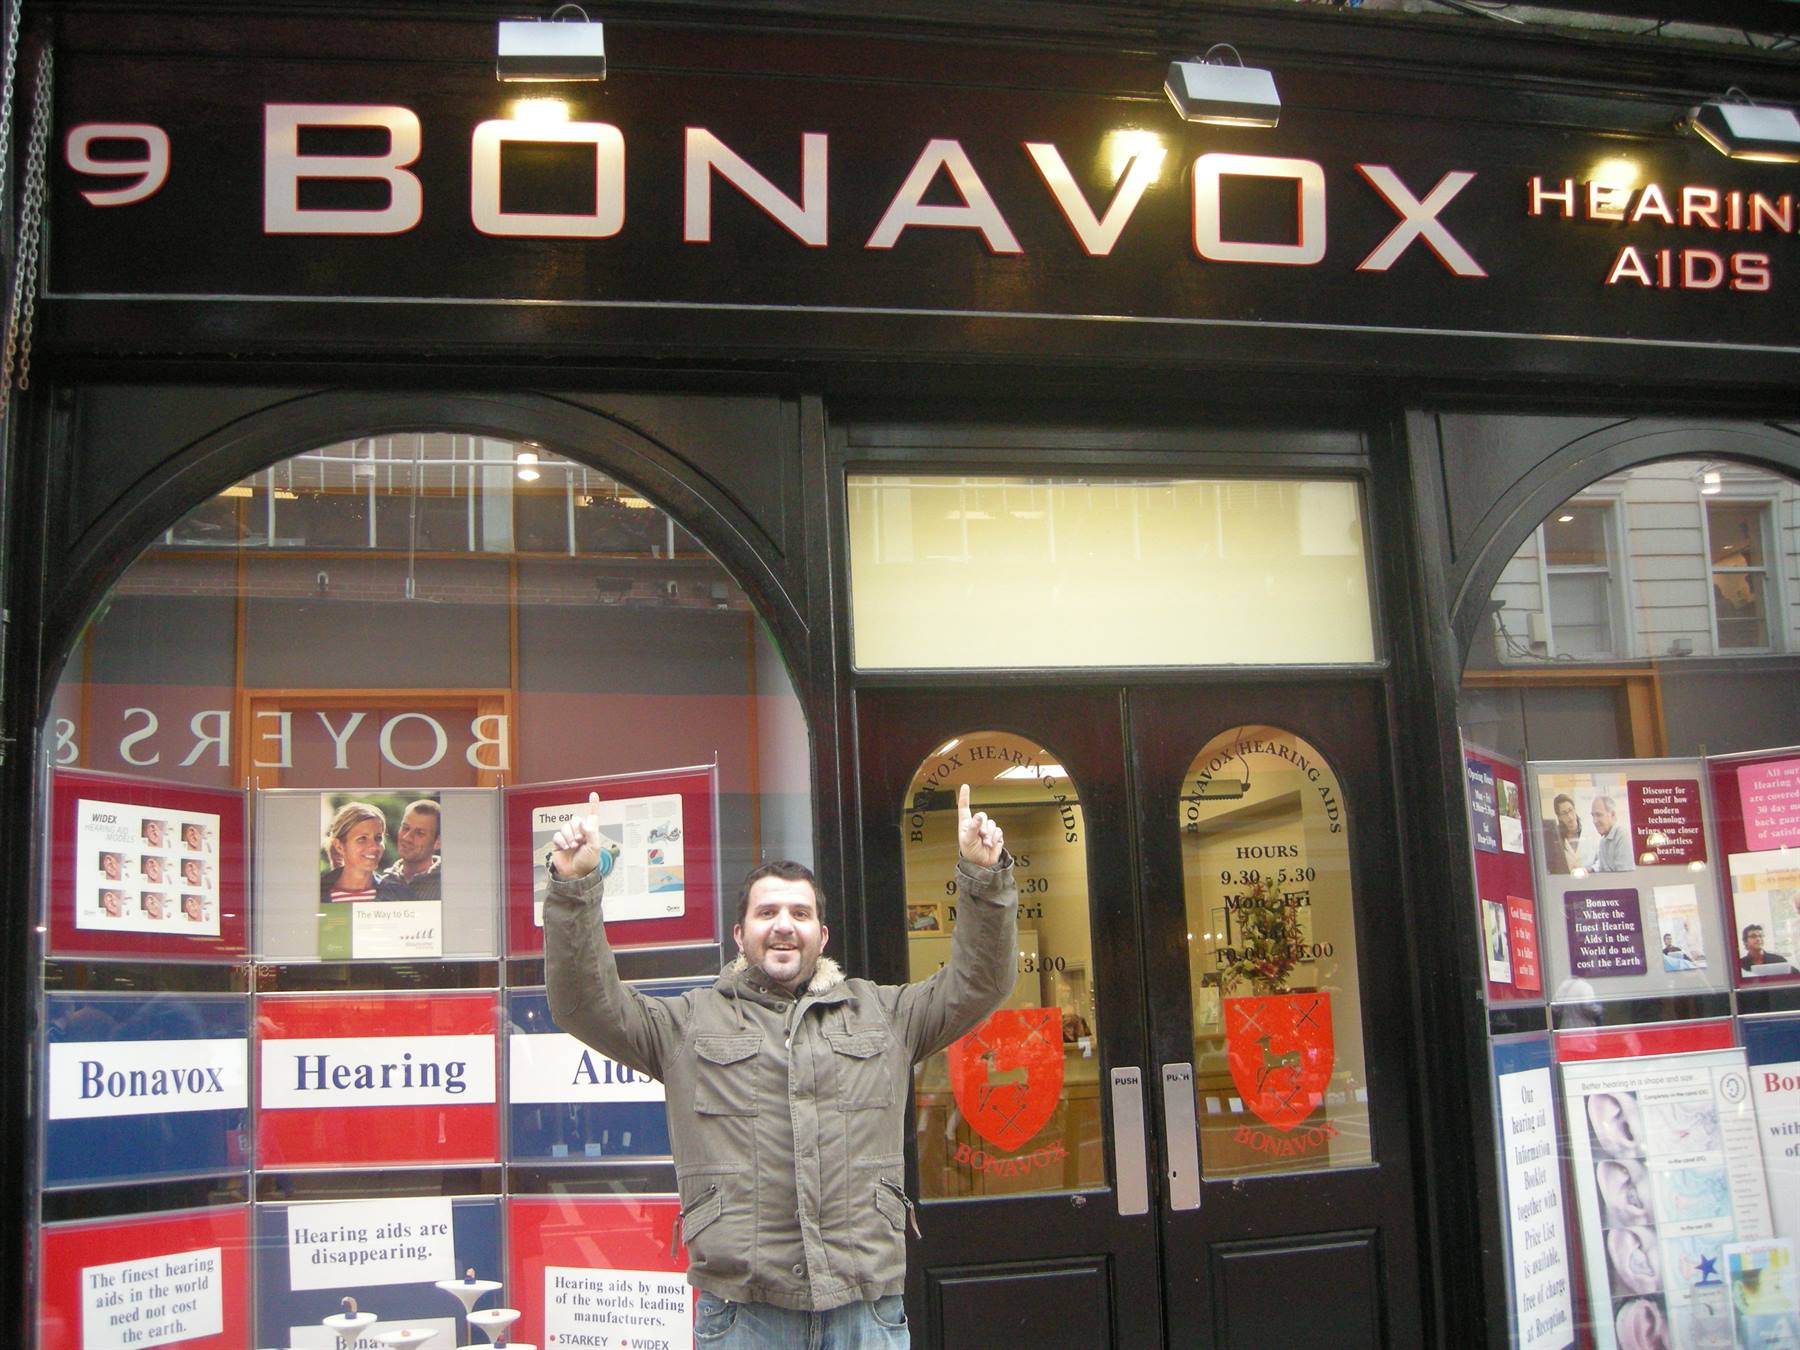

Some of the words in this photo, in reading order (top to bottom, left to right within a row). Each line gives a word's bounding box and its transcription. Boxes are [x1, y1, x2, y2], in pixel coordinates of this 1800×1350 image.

[65, 124, 171, 207] 9
[263, 103, 1488, 278] BONAVOX
[1528, 176, 1800, 233] HEARIN
[1604, 246, 1769, 291] AIDS
[1187, 748, 1234, 833] BONAVOX
[1239, 740, 1321, 783] HEARING
[1318, 785, 1342, 834] AIDS
[1642, 787, 1672, 795] Discover
[1675, 786, 1686, 794] for
[1754, 779, 1791, 790] Hearing
[969, 745, 1057, 790] HEARING
[1053, 793, 1078, 843] AIDS
[1642, 796, 1671, 805] yourself
[1749, 795, 1764, 803] are
[1767, 790, 1800, 801] covered
[92, 813, 118, 824] WIDEX
[539, 813, 557, 824] The
[1770, 805, 1785, 814] day
[1648, 816, 1685, 825] technology
[1754, 816, 1777, 826] back
[1678, 826, 1699, 834] closer
[1758, 829, 1768, 839] of
[1236, 844, 1298, 859] HOURS
[1656, 847, 1685, 855] hearing
[1221, 869, 1260, 885] 9.30
[1278, 867, 1316, 883] 5.30
[1224, 895, 1266, 910] Mon
[1283, 892, 1311, 908] Fri
[1585, 898, 1620, 908] Bonavox
[1583, 910, 1610, 919] Where
[1612, 910, 1625, 918] the
[1575, 923, 1598, 932] finest
[1602, 921, 1635, 931] Hearing
[1584, 934, 1602, 944] Aids
[1605, 934, 1614, 943] in
[1616, 933, 1630, 942] the
[1580, 946, 1606, 956] World
[1609, 946, 1619, 955] do
[1621, 945, 1635, 954] not
[1576, 959, 1595, 969] cost
[1598, 958, 1612, 967] the
[1615, 956, 1641, 966] Earth
[79, 1059, 225, 1100] Bonavox
[294, 1052, 467, 1094] Hearing
[1115, 1077, 1138, 1086] PUSH
[1521, 1086, 1534, 1104] Our
[1512, 1113, 1535, 1135] hearing
[1537, 1109, 1546, 1128] aid
[1233, 1119, 1341, 1157] BONAVOX
[954, 1138, 1071, 1177] BONAVOX
[1515, 1140, 1550, 1165] Information
[1524, 1167, 1546, 1190] Booklet
[1518, 1196, 1543, 1222] together
[1544, 1189, 1557, 1208] with
[294, 1226, 368, 1244] Hearing
[376, 1222, 412, 1240] aids
[420, 1223, 448, 1237] are
[1525, 1228, 1541, 1250] Price
[1543, 1222, 1555, 1241] List
[311, 1243, 433, 1266] disappearing.
[90, 1273, 116, 1289] The
[122, 1267, 159, 1284] finest
[166, 1258, 214, 1277] hearing
[96, 1291, 124, 1308] aids
[130, 1288, 143, 1303] in
[149, 1284, 169, 1299] the
[175, 1276, 209, 1294] world
[555, 1276, 604, 1293] Hearing
[609, 1279, 633, 1292] aids
[639, 1281, 650, 1296] by
[657, 1285, 685, 1295] most
[556, 1292, 567, 1304] of
[573, 1294, 591, 1306] the
[596, 1296, 634, 1309] worlds
[640, 1298, 685, 1313] leading
[110, 1307, 139, 1326] need
[146, 1305, 166, 1319] not
[172, 1299, 197, 1314] cost
[574, 1311, 666, 1327] manufacturers.
[123, 1328, 143, 1344] the
[148, 1319, 187, 1338] earth.
[559, 1333, 609, 1348] STARKEY
[631, 1339, 669, 1350] WIDEX
